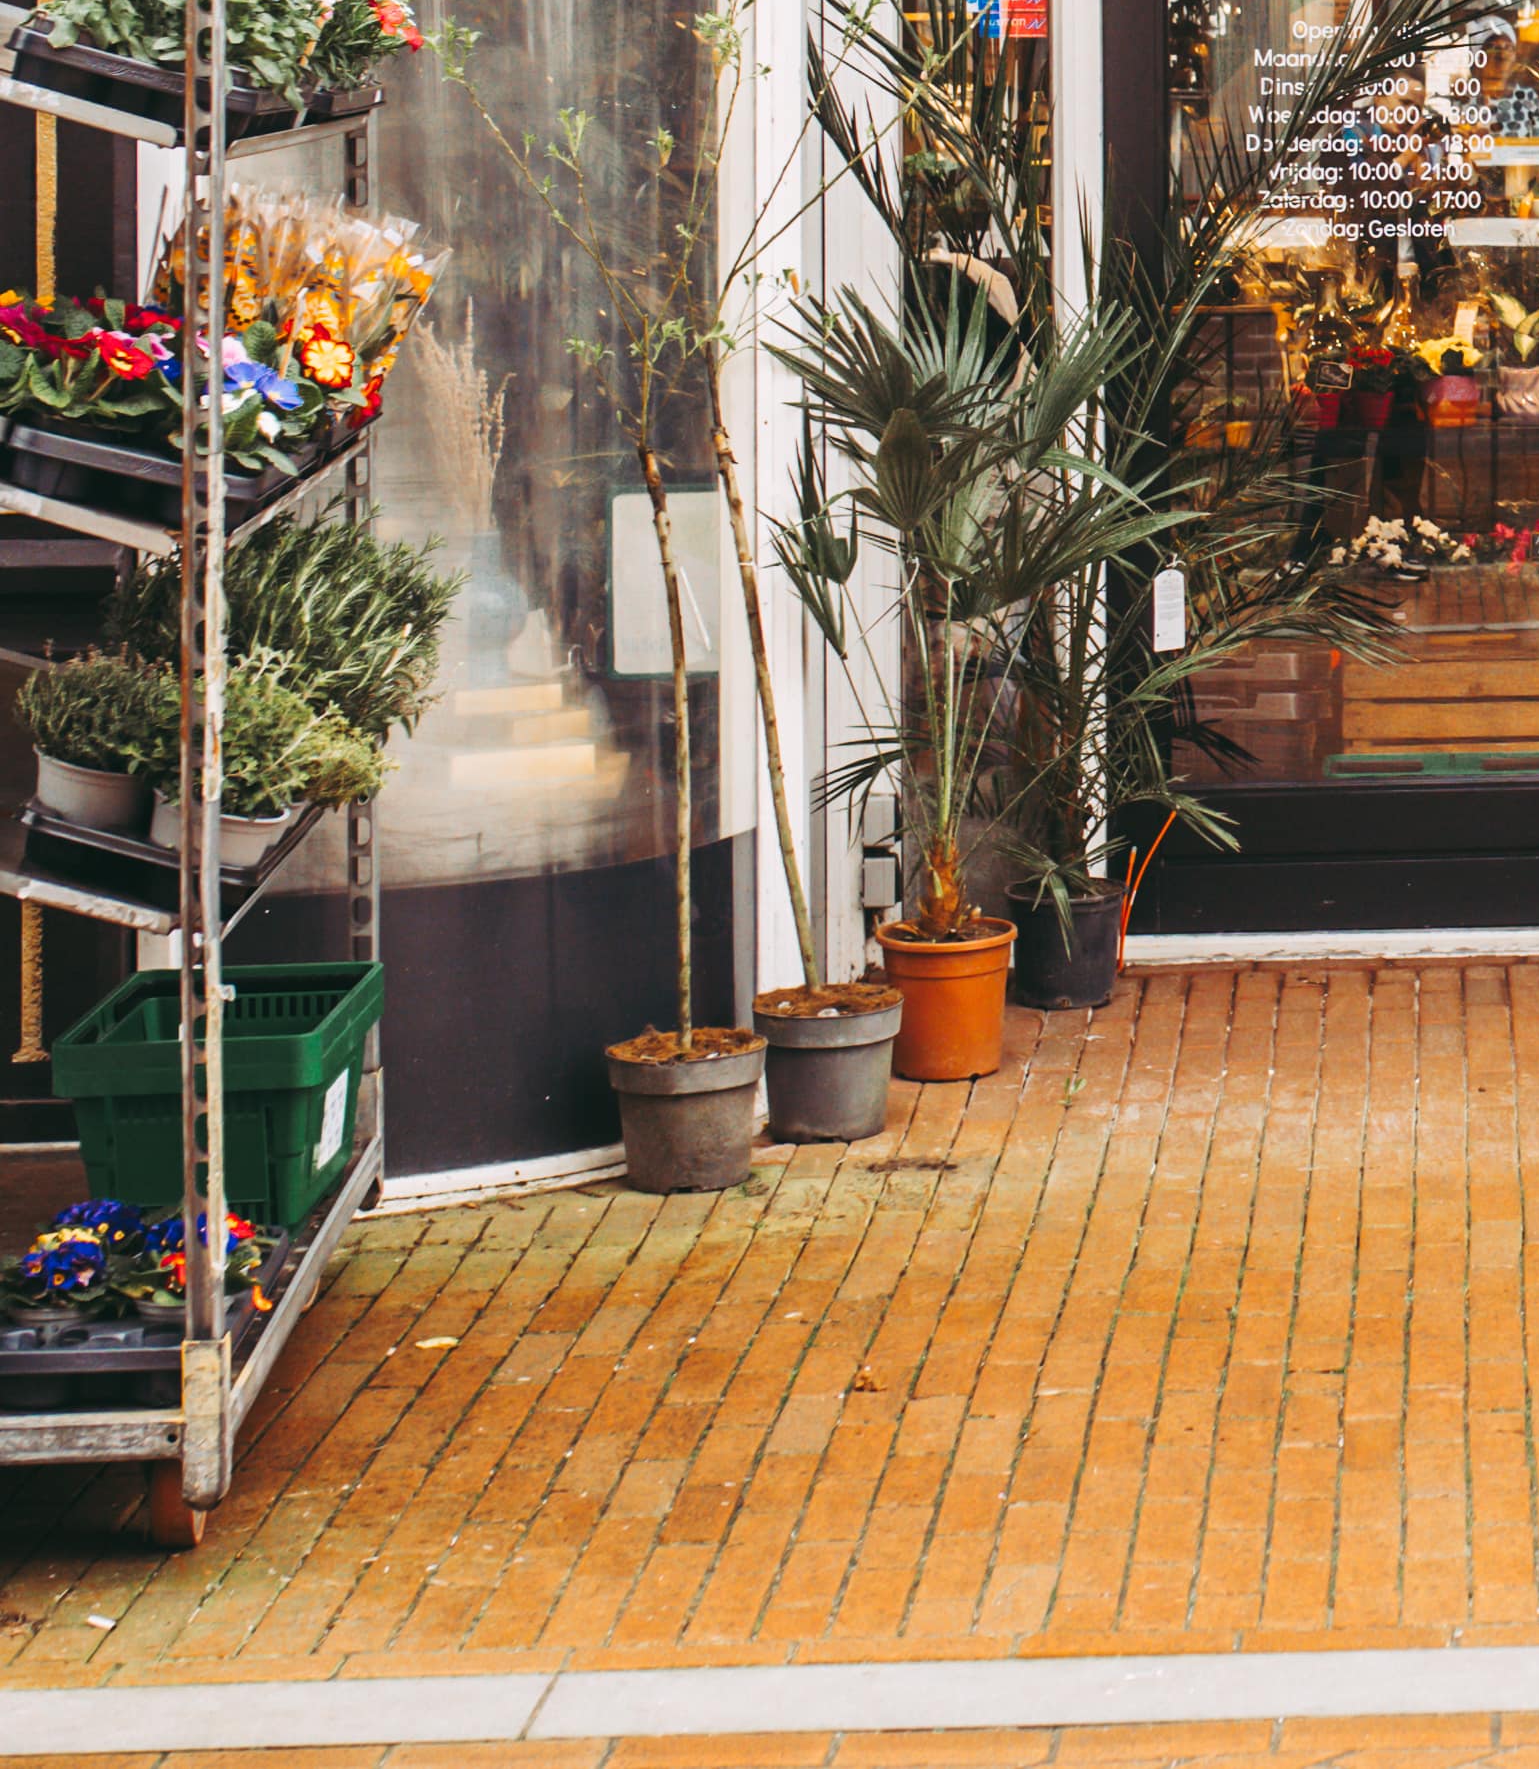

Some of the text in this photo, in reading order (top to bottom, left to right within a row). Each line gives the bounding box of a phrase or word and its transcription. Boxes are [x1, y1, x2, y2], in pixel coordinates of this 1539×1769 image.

[1366, 105, 1420, 125] 10:00
[1368, 133, 1423, 153] 10:00
[1440, 134, 1495, 154] 18:00
[1269, 161, 1344, 186] Vrijdag:
[1348, 161, 1403, 181] 10:00
[1420, 162, 1473, 182] 21:00
[1360, 190, 1414, 209] 10:00
[1431, 190, 1482, 210] 17:00
[1367, 217, 1457, 240] Gesloten
